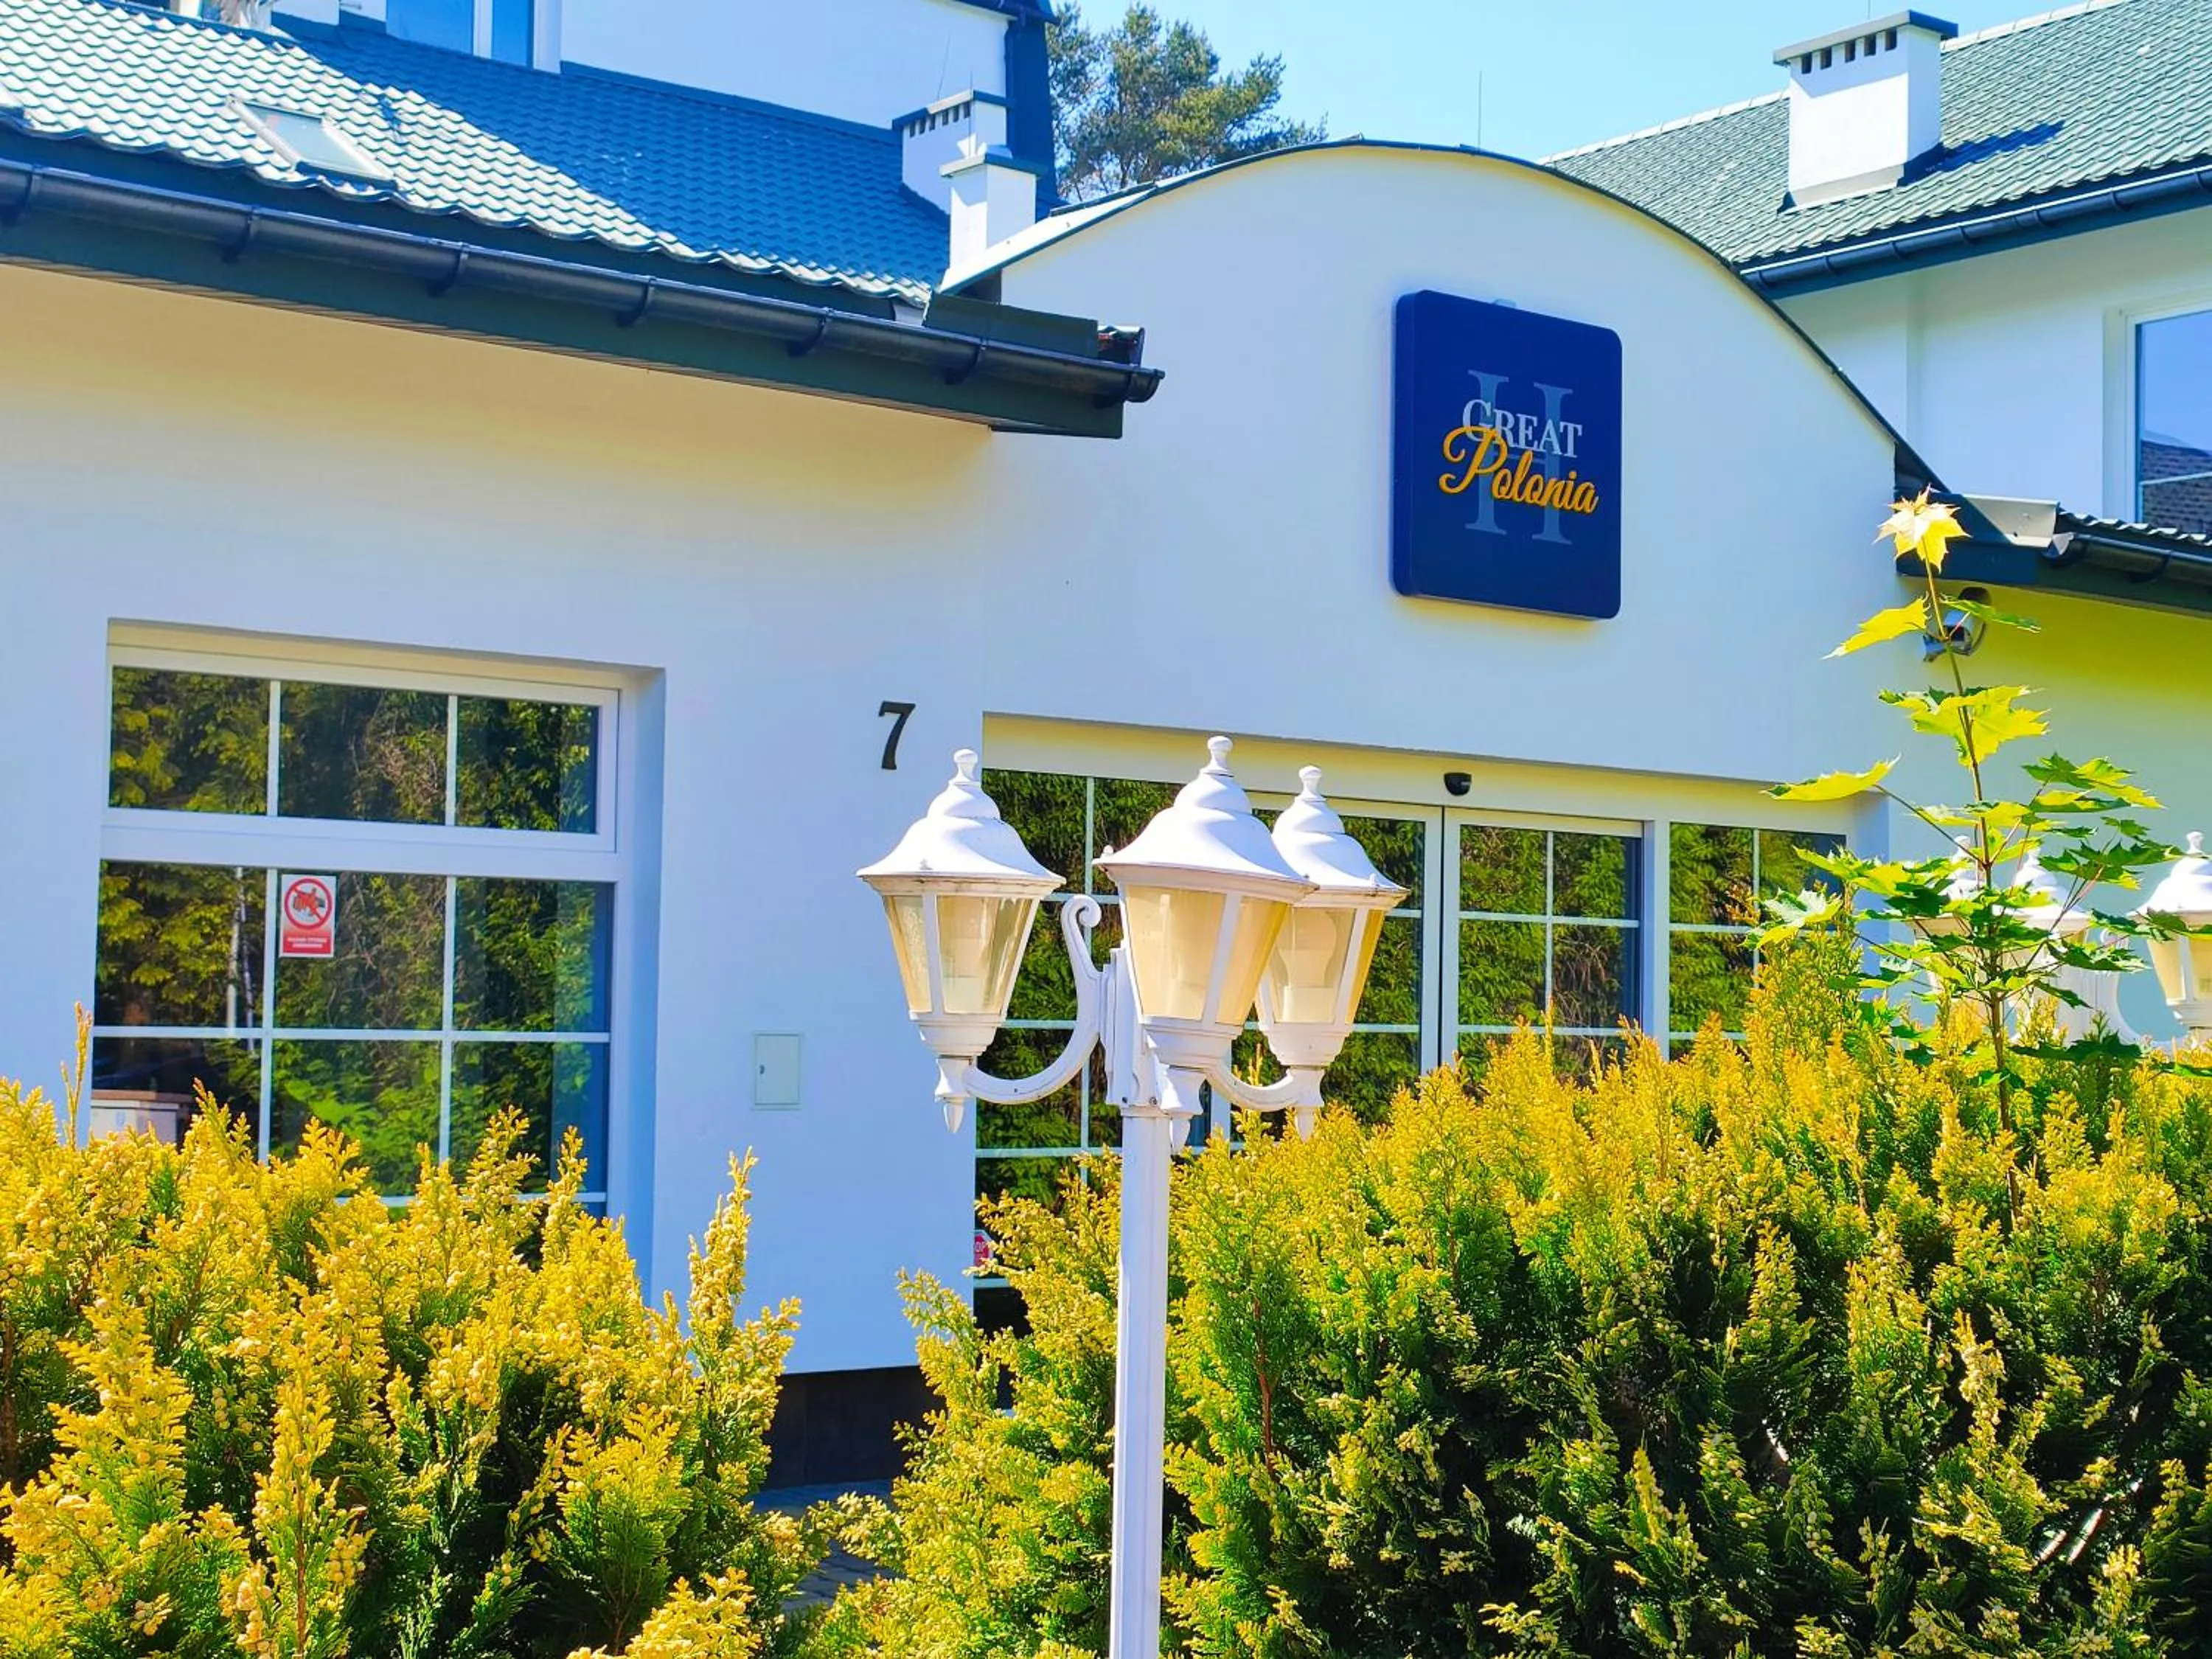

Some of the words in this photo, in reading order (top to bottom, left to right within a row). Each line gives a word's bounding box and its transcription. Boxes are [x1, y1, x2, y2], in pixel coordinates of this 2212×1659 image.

[1462, 399, 1584, 459] GREAT
[1439, 425, 1599, 514] Polonia
[878, 700, 917, 770] 7
